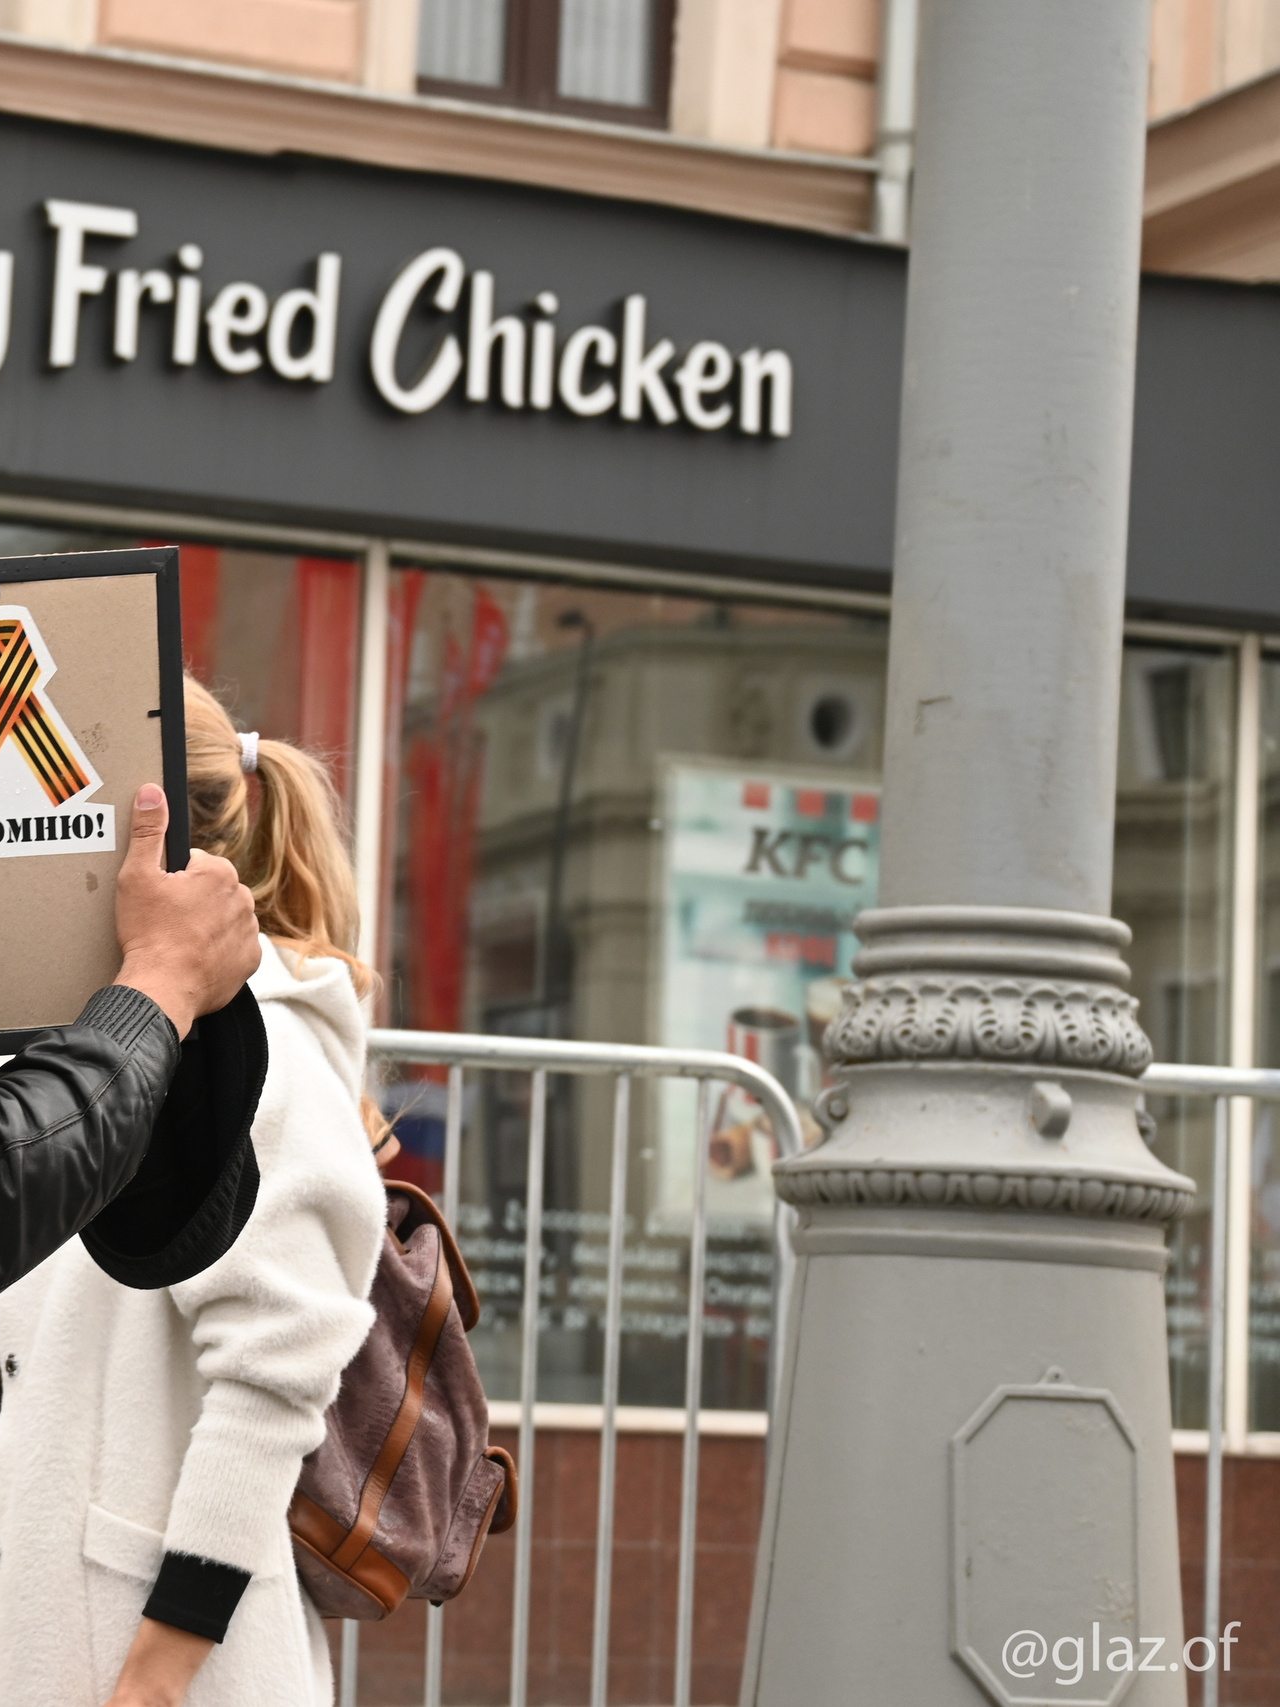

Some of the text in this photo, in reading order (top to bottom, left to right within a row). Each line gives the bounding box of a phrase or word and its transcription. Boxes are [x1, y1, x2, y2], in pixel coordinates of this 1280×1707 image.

[46, 198, 340, 382] Fried
[370, 247, 793, 437] Chicken
[743, 826, 869, 886] KFC
